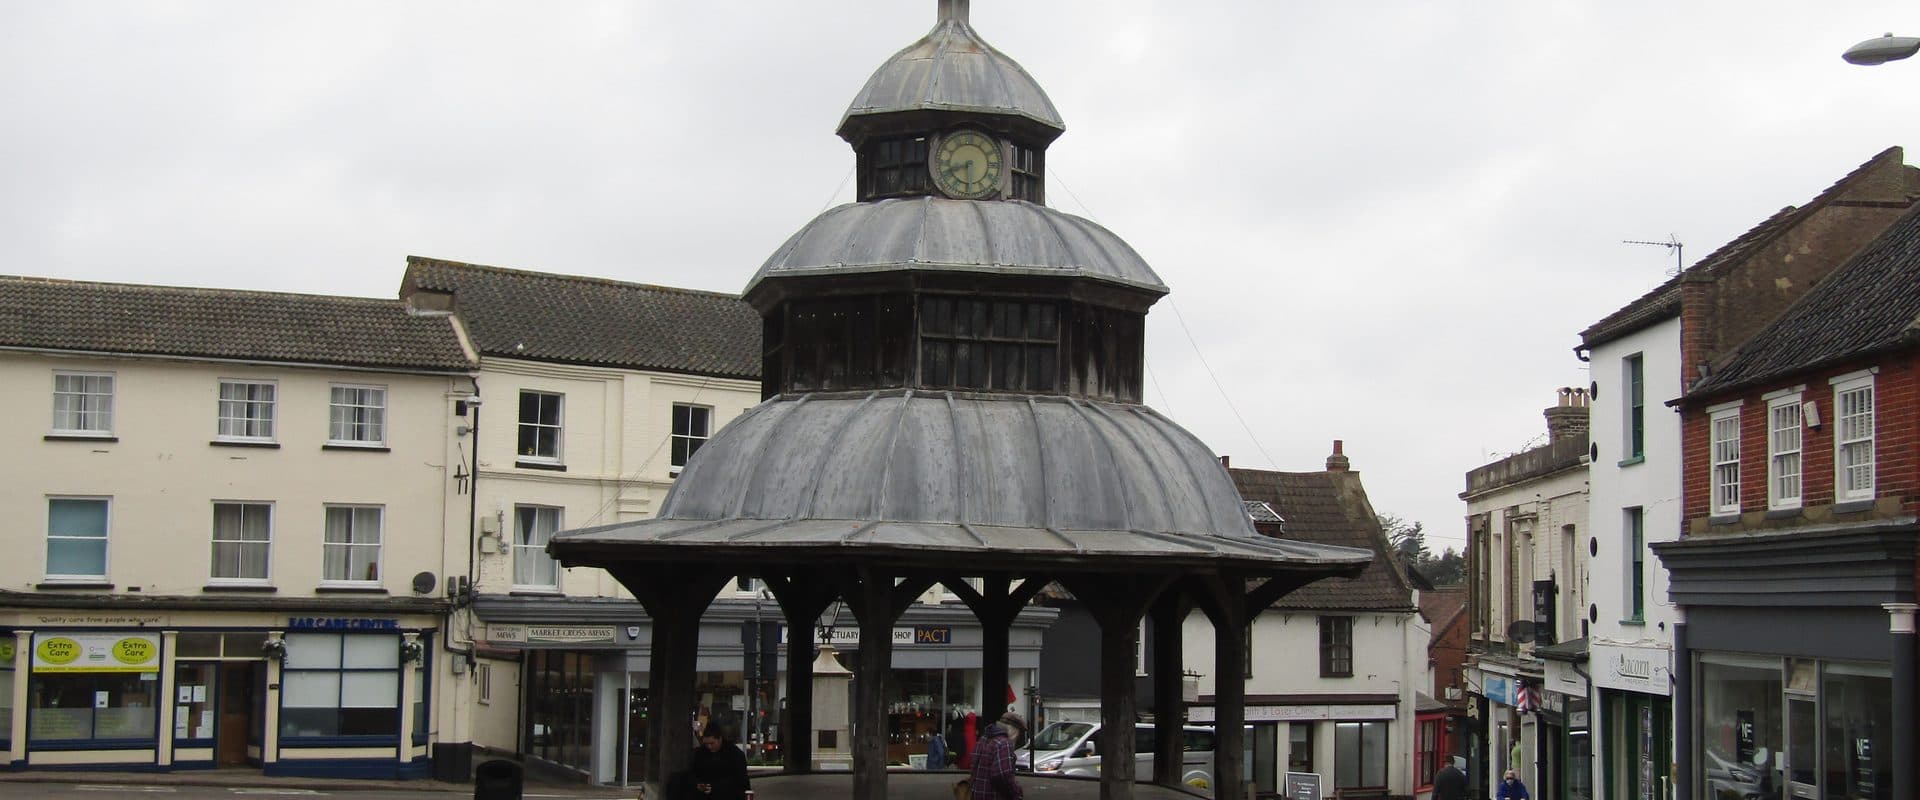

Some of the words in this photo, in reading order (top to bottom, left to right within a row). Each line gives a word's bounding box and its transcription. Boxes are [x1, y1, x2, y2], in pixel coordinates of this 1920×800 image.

[105, 616, 126, 624] people
[289, 618, 314, 629] EAR
[316, 618, 349, 629] CARE
[352, 618, 400, 630] CENTRE
[495, 631, 517, 640] MEWS
[531, 629, 560, 637] MARKET
[563, 629, 586, 637] CROSS
[588, 629, 610, 637] MEWS
[817, 630, 859, 639] SCTUARY
[894, 631, 911, 639] SHOP
[917, 630, 948, 642] PACT
[47, 641, 73, 649] Extra
[122, 641, 147, 649] Extra
[49, 649, 70, 657] Care
[124, 649, 145, 657] Care
[1624, 659, 1650, 676] acorn
